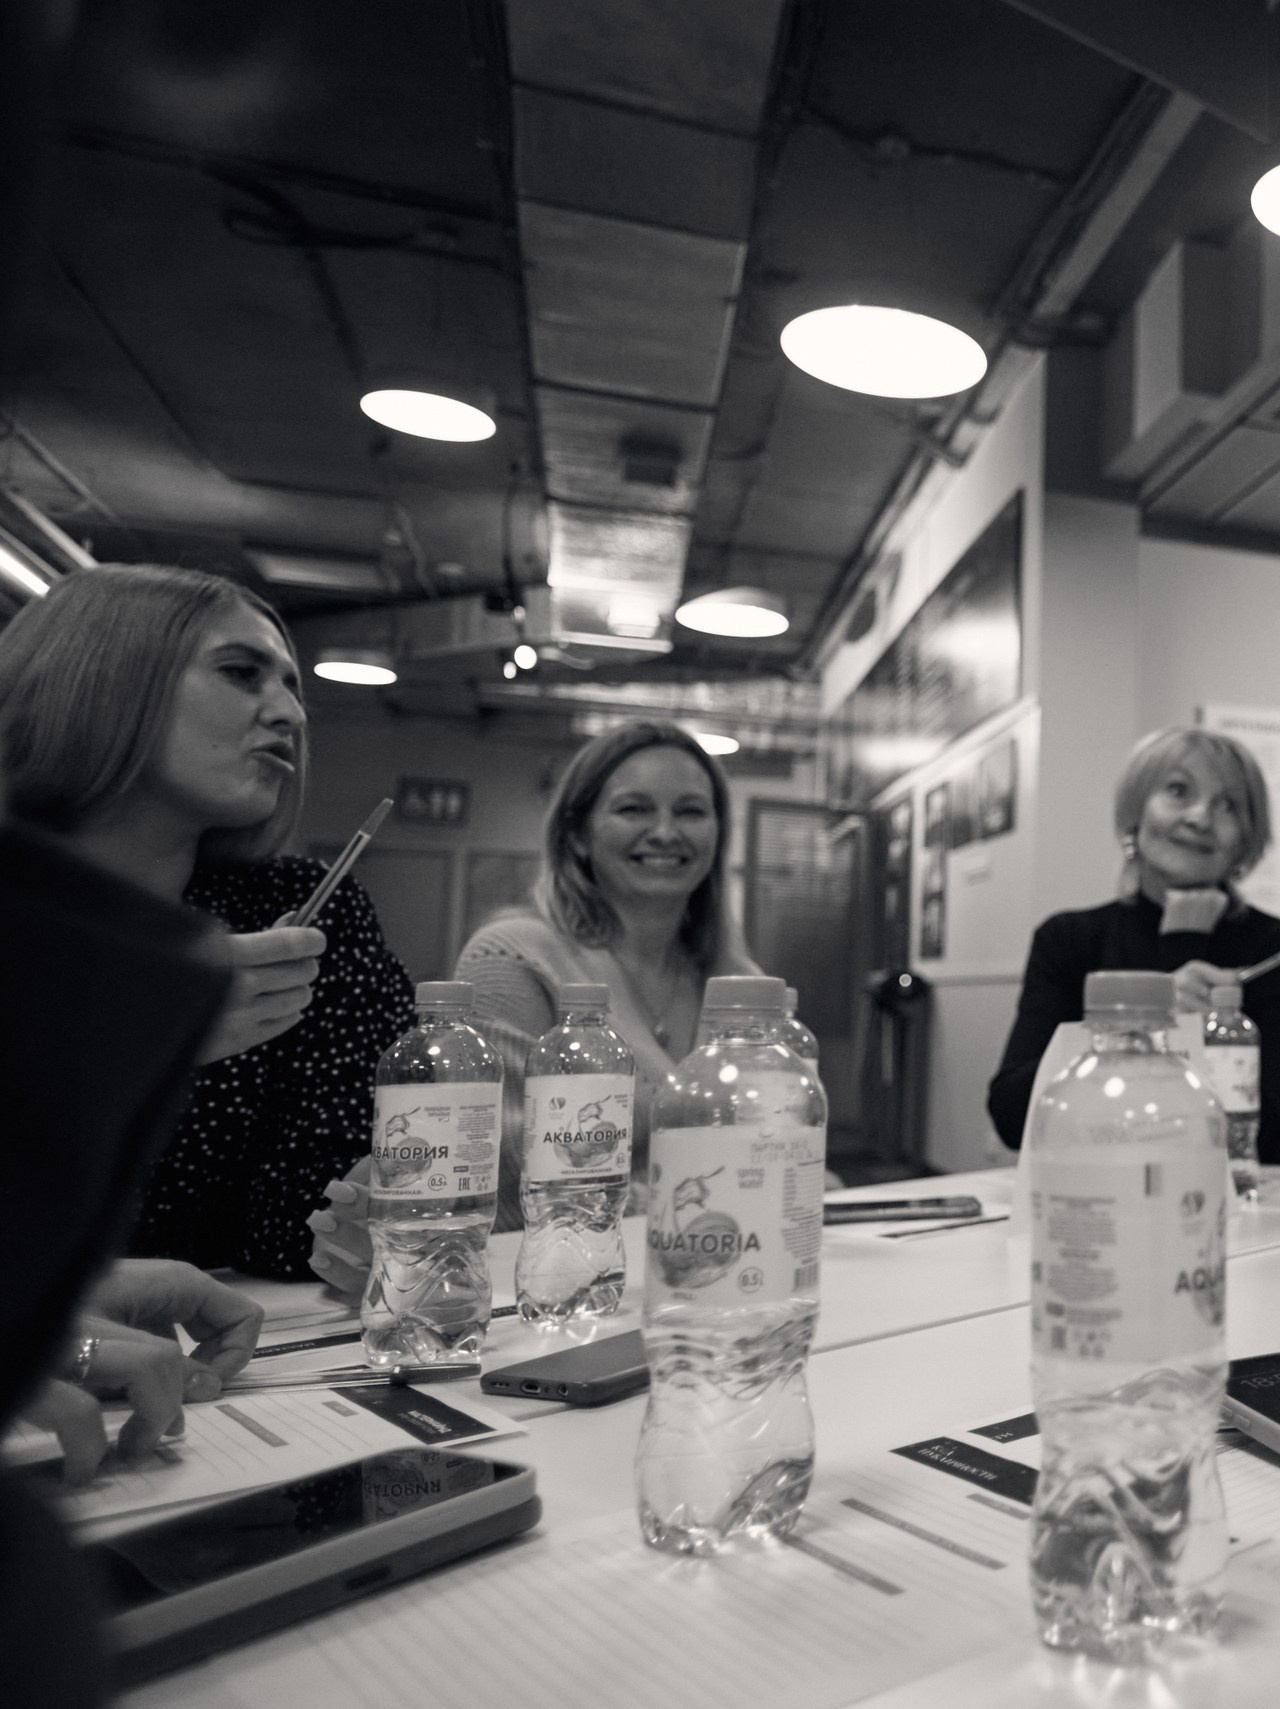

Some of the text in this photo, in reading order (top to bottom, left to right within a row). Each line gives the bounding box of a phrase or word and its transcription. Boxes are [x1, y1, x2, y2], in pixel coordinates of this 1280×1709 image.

[543, 1128, 627, 1143] АКВАТОРИЯ
[372, 1145, 449, 1160] ВАТОРИЯ
[651, 1231, 761, 1253] QUATORIA
